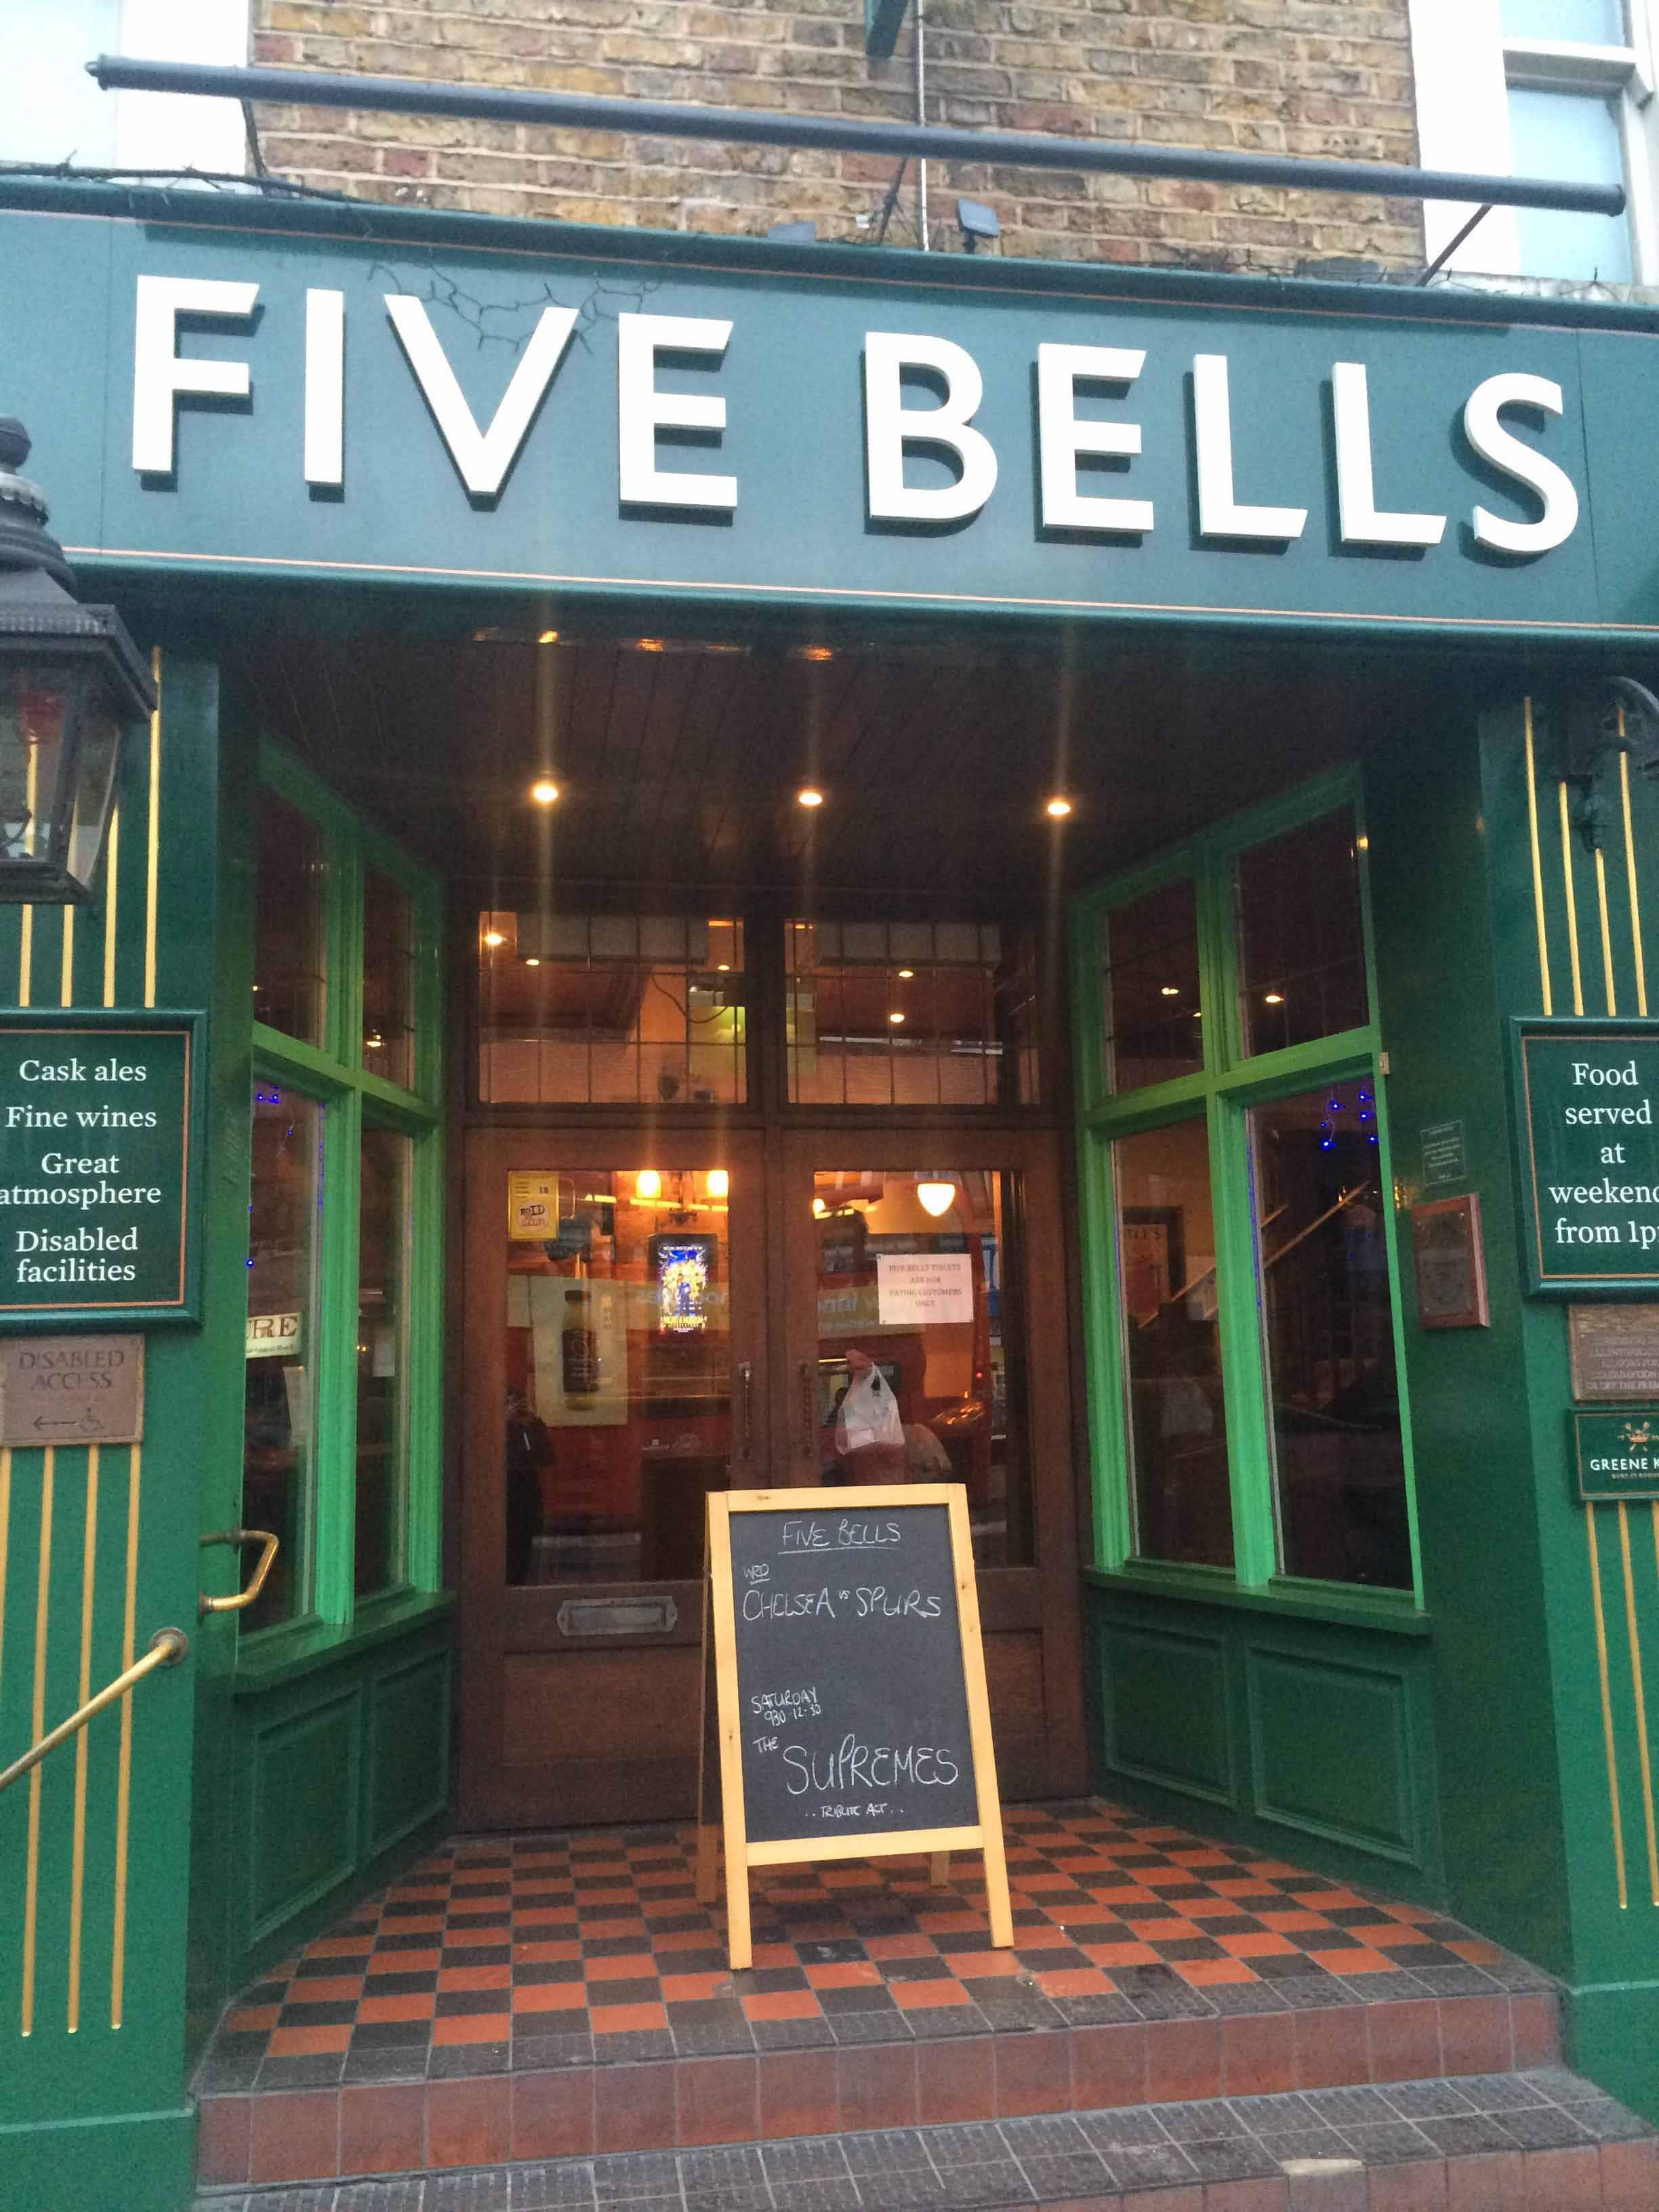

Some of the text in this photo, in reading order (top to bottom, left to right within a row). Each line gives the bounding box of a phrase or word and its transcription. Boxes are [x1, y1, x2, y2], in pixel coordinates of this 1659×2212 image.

[131, 275, 1580, 556] FIVE BELLS
[19, 1058, 146, 1082] Cask ales
[1572, 1061, 1639, 1086] Food
[5, 1105, 157, 1128] Fine wines
[1565, 1099, 1652, 1125] served
[41, 1153, 119, 1174] Great
[1600, 1143, 1626, 1164] at
[0, 1181, 161, 1210] atmosphere
[16, 1227, 138, 1252] Disabled
[1555, 1218, 1659, 1250] from 1p
[16, 1258, 136, 1283] facilities
[19, 1350, 124, 1370] DISABLED
[32, 1372, 112, 1390] ACCESS
[1590, 1458, 1648, 1471] GREENE
[782, 1519, 901, 1547] FIVE BELLS
[743, 1587, 836, 1621] CHELSEA
[856, 1586, 941, 1618] SPURS
[751, 1687, 817, 1714] SATURDAY
[752, 1736, 779, 1754] THE
[783, 1734, 959, 1795] SUPREMES
